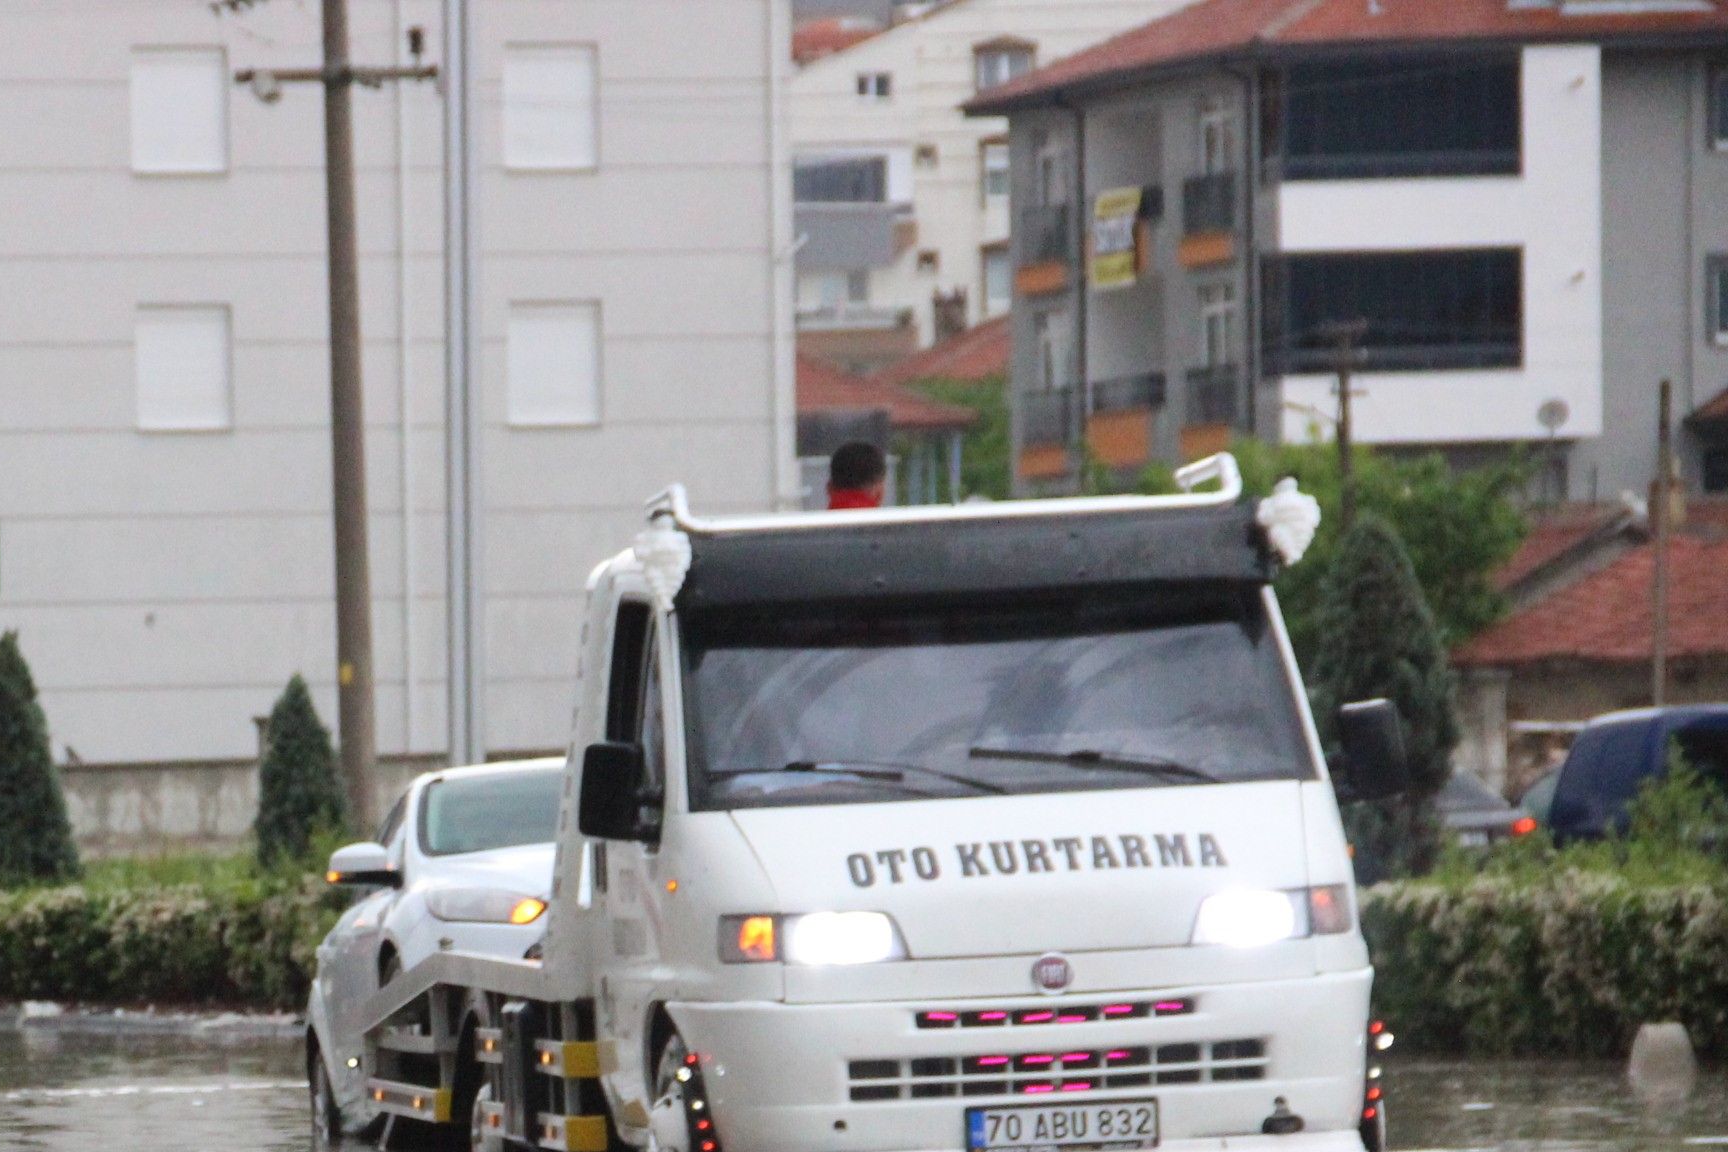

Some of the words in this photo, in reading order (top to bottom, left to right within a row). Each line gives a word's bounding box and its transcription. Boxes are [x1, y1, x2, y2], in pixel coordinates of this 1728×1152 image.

[846, 846, 940, 888] OTO
[956, 833, 1227, 877] KURTARMA
[987, 1114, 1022, 1142] 70
[1035, 1110, 1088, 1140] ABU
[1097, 1107, 1151, 1137] 832
